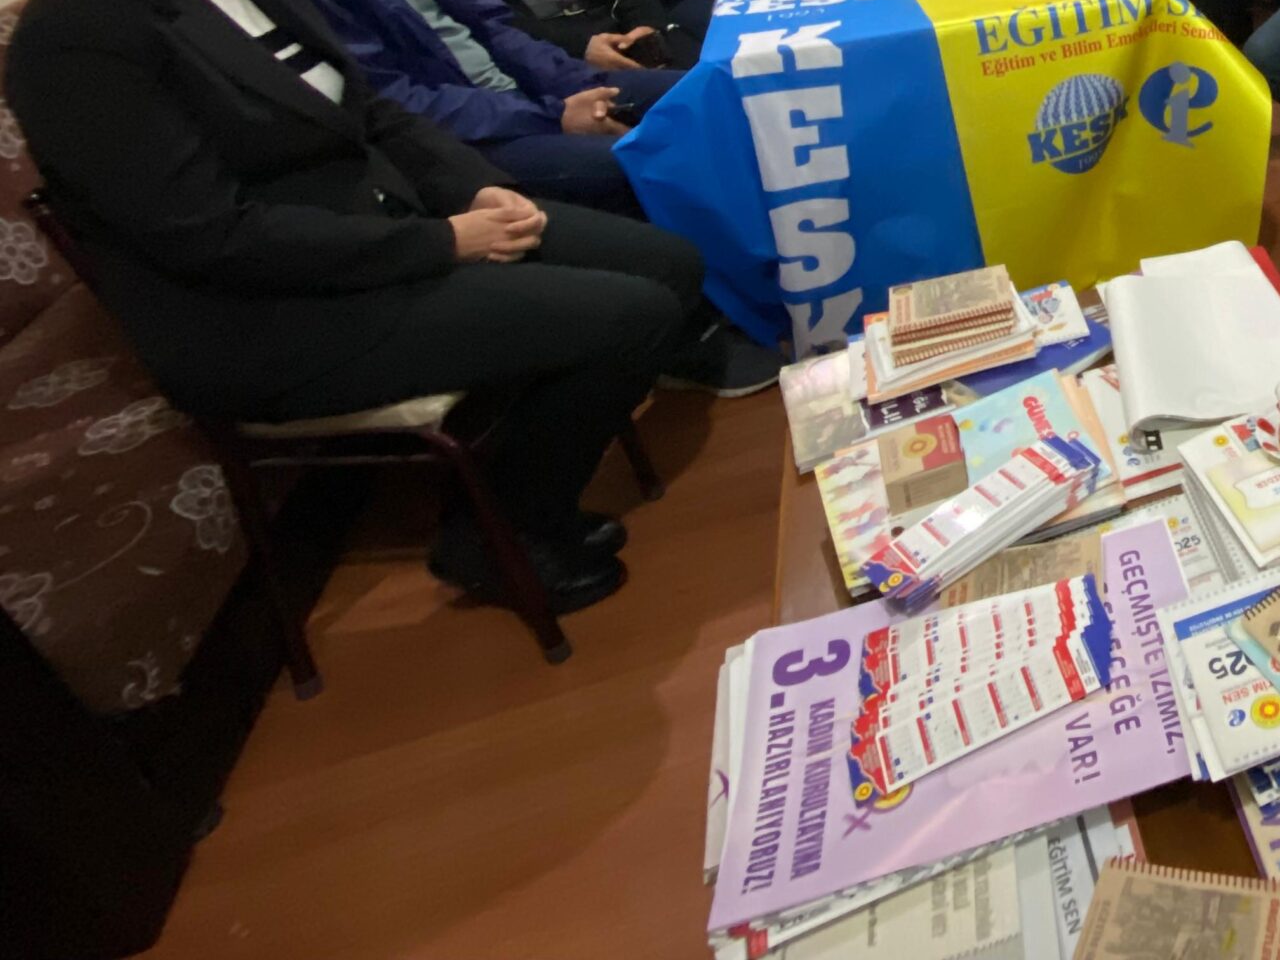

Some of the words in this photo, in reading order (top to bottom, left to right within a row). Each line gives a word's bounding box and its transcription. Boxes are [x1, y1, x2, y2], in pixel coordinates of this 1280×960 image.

[981, 53, 1036, 78] Eğitim
[1039, 49, 1057, 63] ve
[1061, 38, 1103, 59] Bilim
[731, 20, 863, 364] KESK
[806, 697, 836, 758] KADIN
[1065, 713, 1102, 787] VAR!
[741, 709, 796, 896] HAZIRLANIYORUZ!
[1061, 897, 1083, 936] SEN
